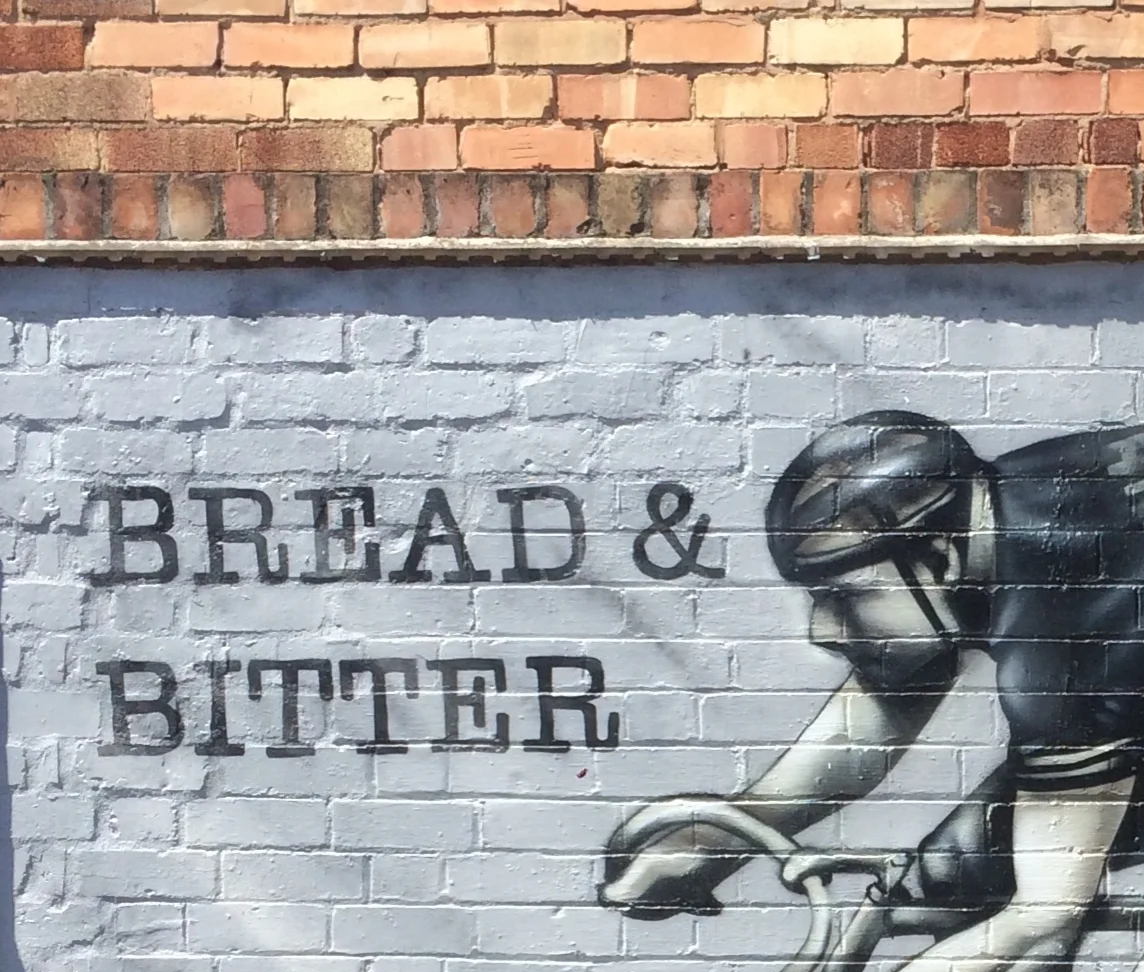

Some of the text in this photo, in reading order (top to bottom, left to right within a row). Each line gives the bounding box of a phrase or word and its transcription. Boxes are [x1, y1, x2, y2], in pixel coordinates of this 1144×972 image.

[89, 480, 727, 586] BREAD &
[96, 656, 620, 758] BITTER
